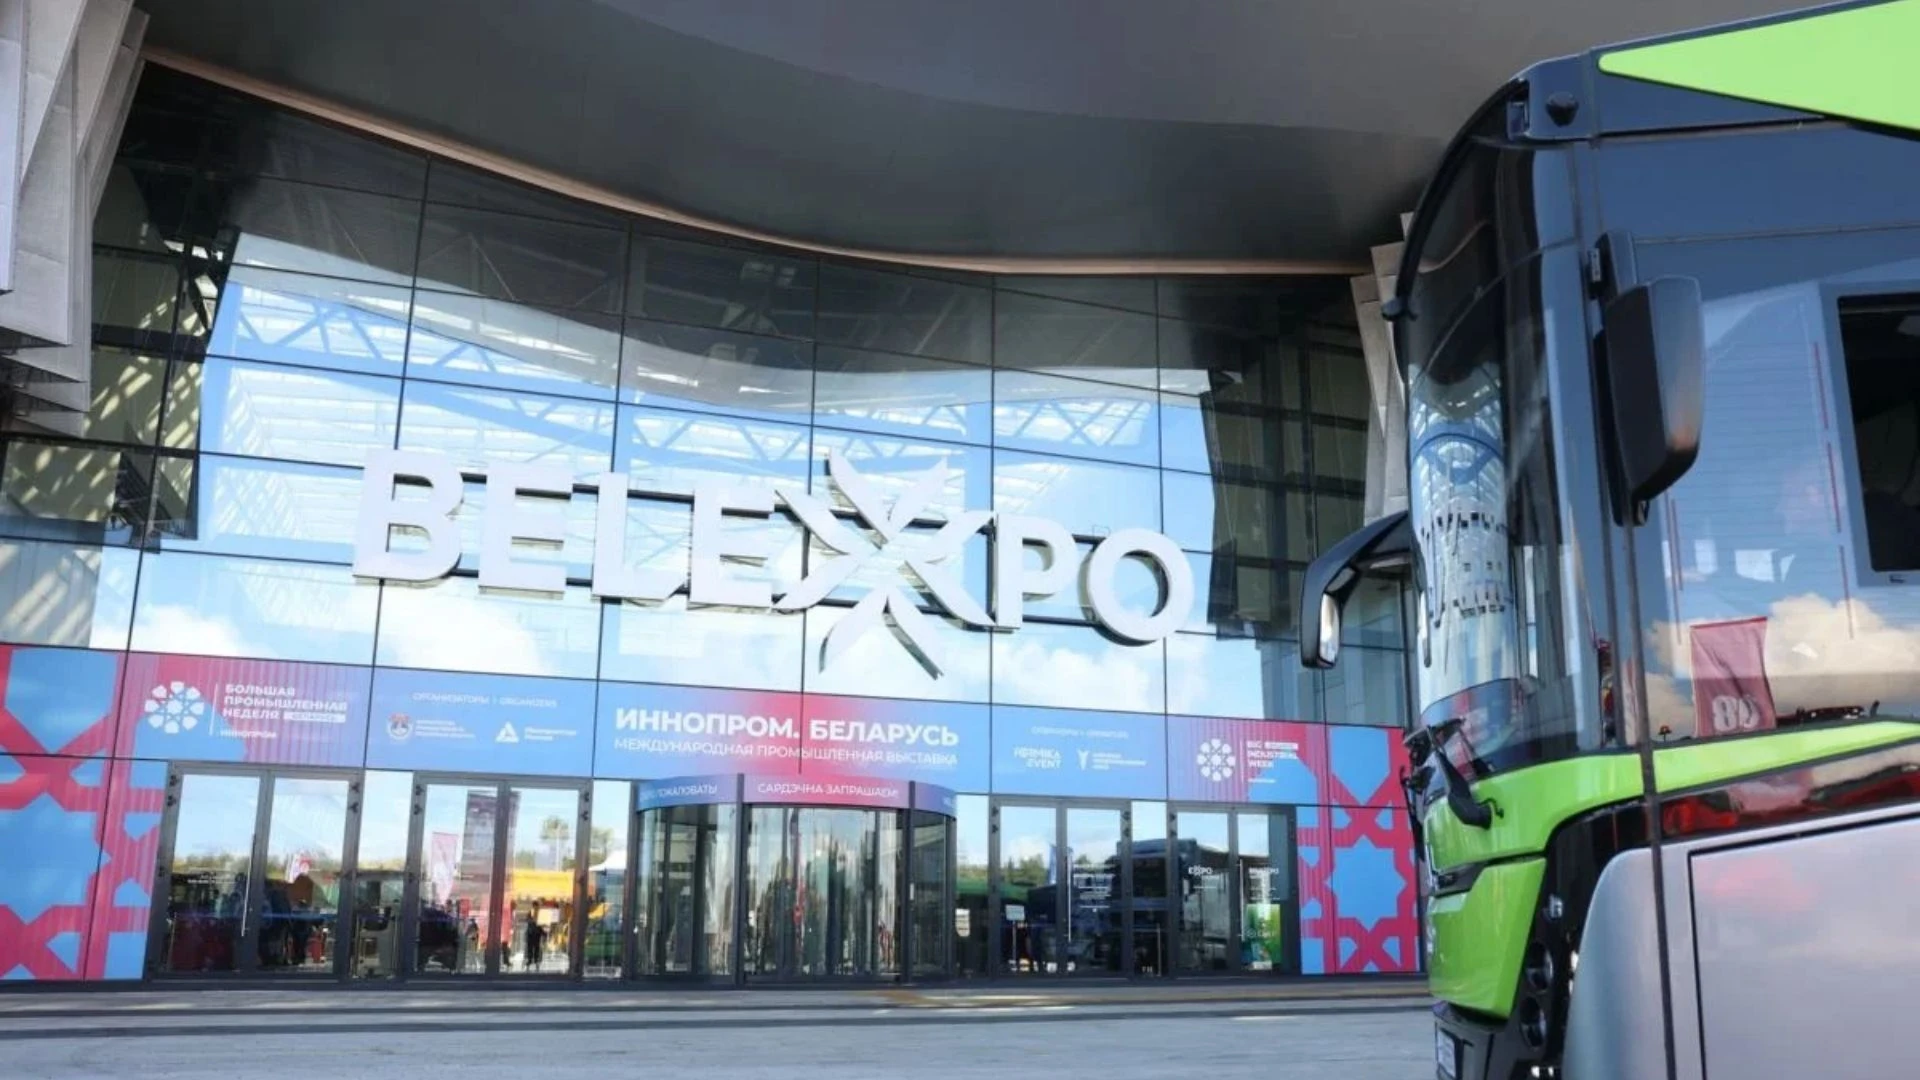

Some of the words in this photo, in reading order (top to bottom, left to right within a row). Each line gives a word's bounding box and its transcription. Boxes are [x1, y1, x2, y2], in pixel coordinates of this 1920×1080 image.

[225, 683, 296, 697] БОЛЬШАЯ
[223, 695, 348, 712] ПРОМЫШЛЕННАЯ
[222, 708, 281, 720] НЕДЕЛЯ
[615, 707, 800, 739] ИННОПРОМ.
[809, 718, 959, 747] БЕЛАРУСЬ
[614, 737, 753, 757] МЕЖДУНАРОДНАЯ
[756, 744, 884, 763] ПРОМЫШЛЕННАЯ
[886, 750, 958, 766] ВЫСТАВКА
[757, 783, 825, 795] САРДЭЧНА
